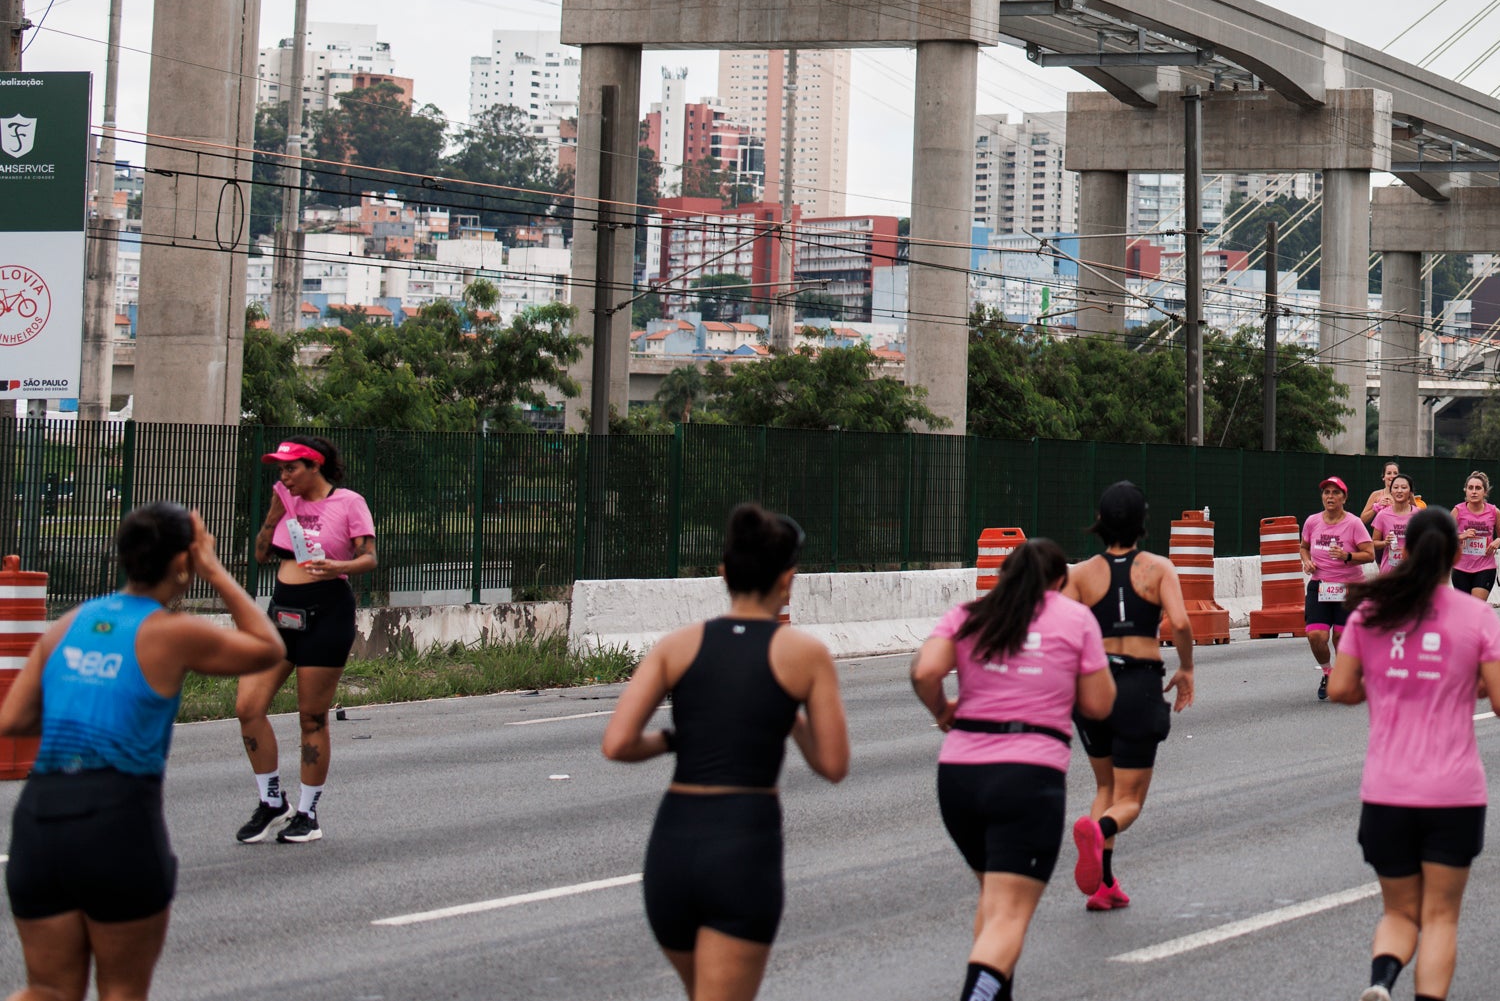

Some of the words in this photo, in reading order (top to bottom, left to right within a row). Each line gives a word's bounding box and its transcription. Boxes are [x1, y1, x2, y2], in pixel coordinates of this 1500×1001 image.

[0, 77, 44, 87] ealização:
[23, 378, 40, 387] SÃO
[41, 379, 69, 387] PAULO
[1469, 541, 1484, 549] 4516
[267, 776, 280, 798] RUN
